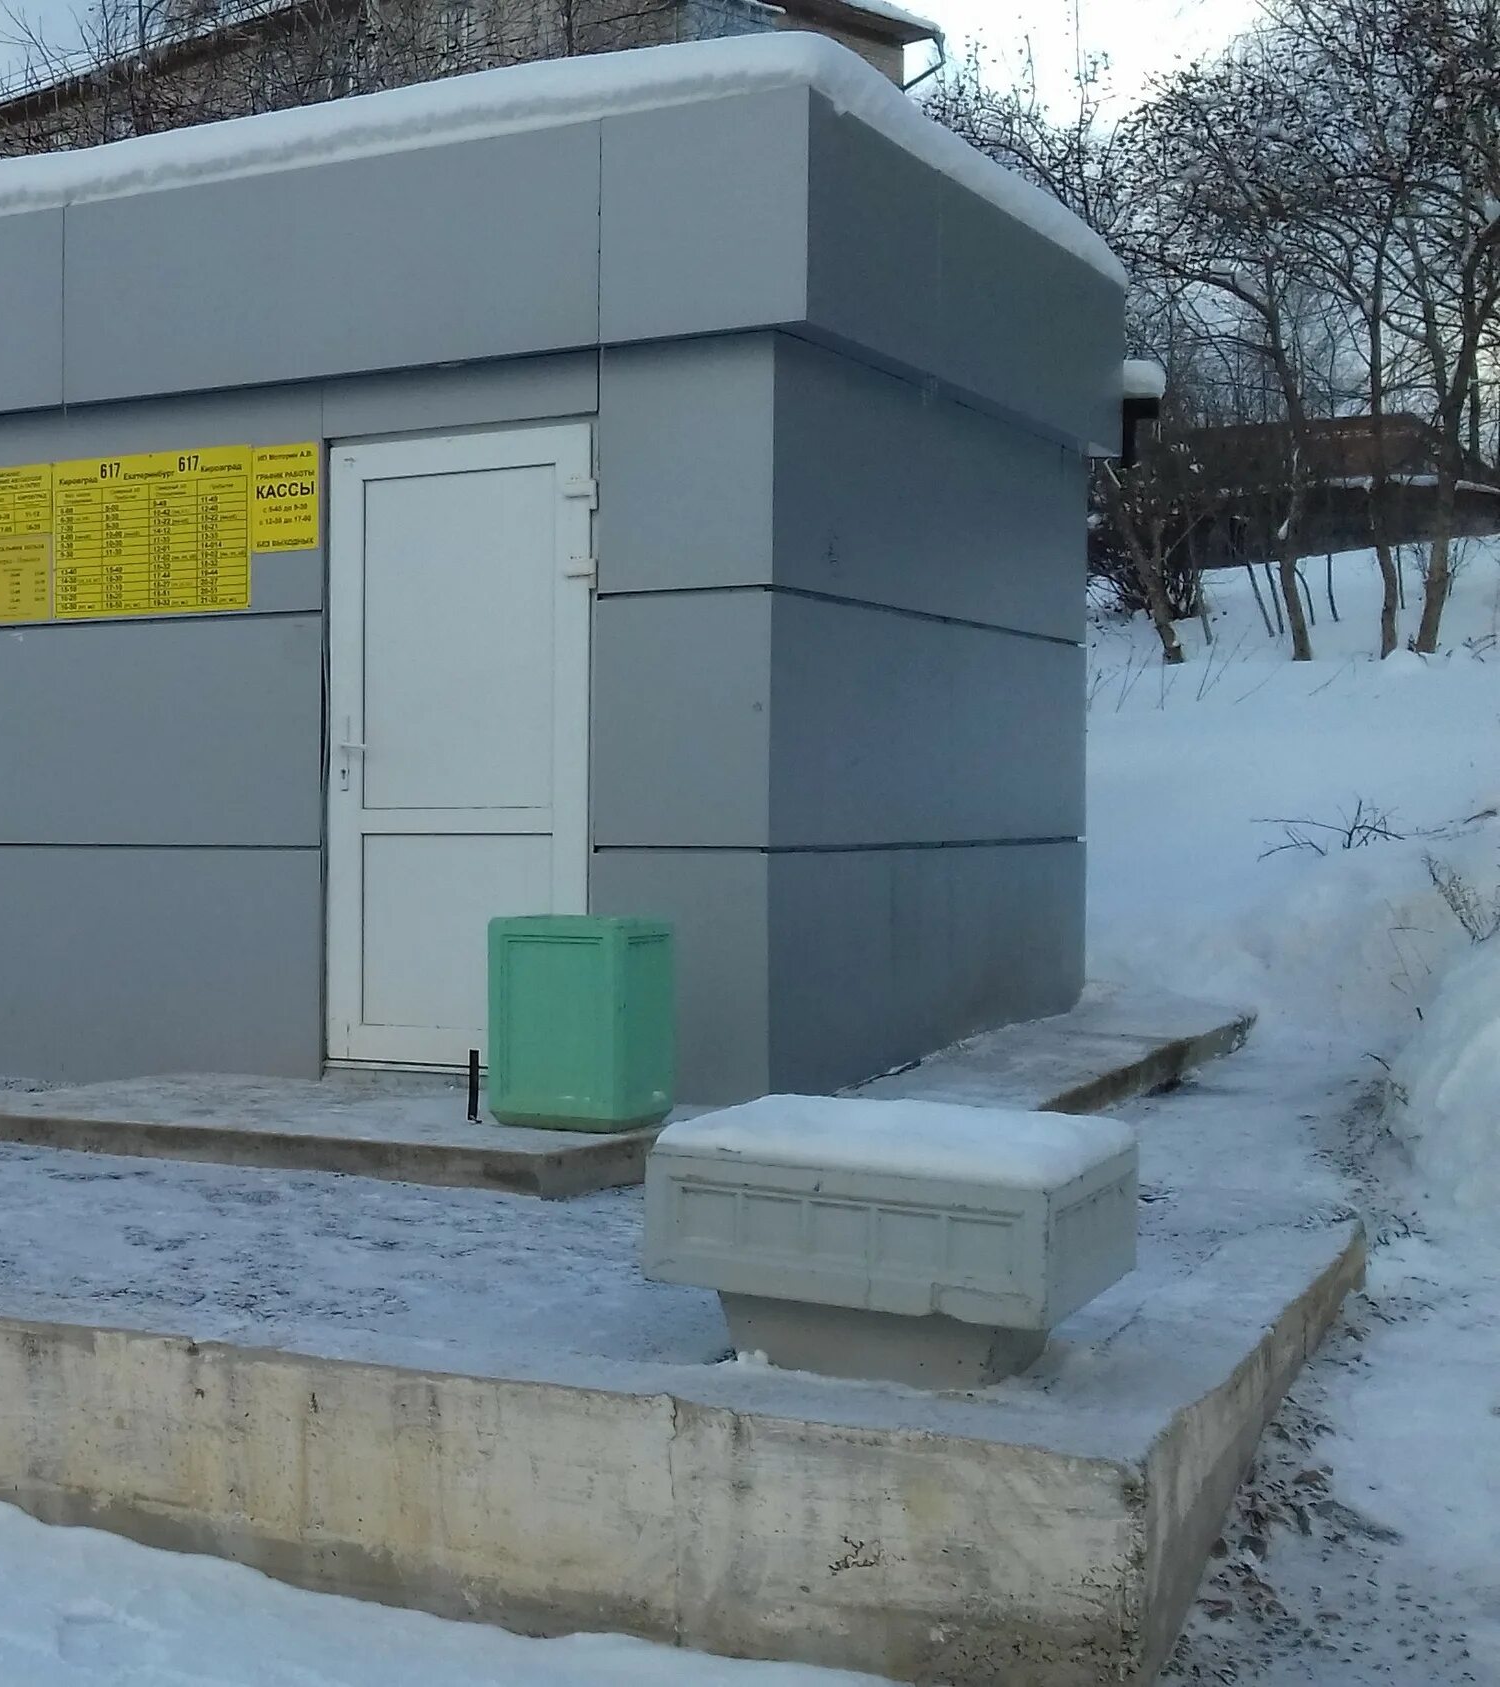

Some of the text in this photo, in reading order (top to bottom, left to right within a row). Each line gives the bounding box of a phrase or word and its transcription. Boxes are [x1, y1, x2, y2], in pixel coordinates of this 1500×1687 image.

[179, 455, 199, 472] 617
[201, 463, 243, 473] Кировград
[100, 462, 120, 479] 617
[123, 470, 175, 481] Екатеринбург
[285, 469, 315, 478] РАБОТЫ
[59, 477, 98, 486] Кировград
[256, 481, 315, 499] КАССЫ
